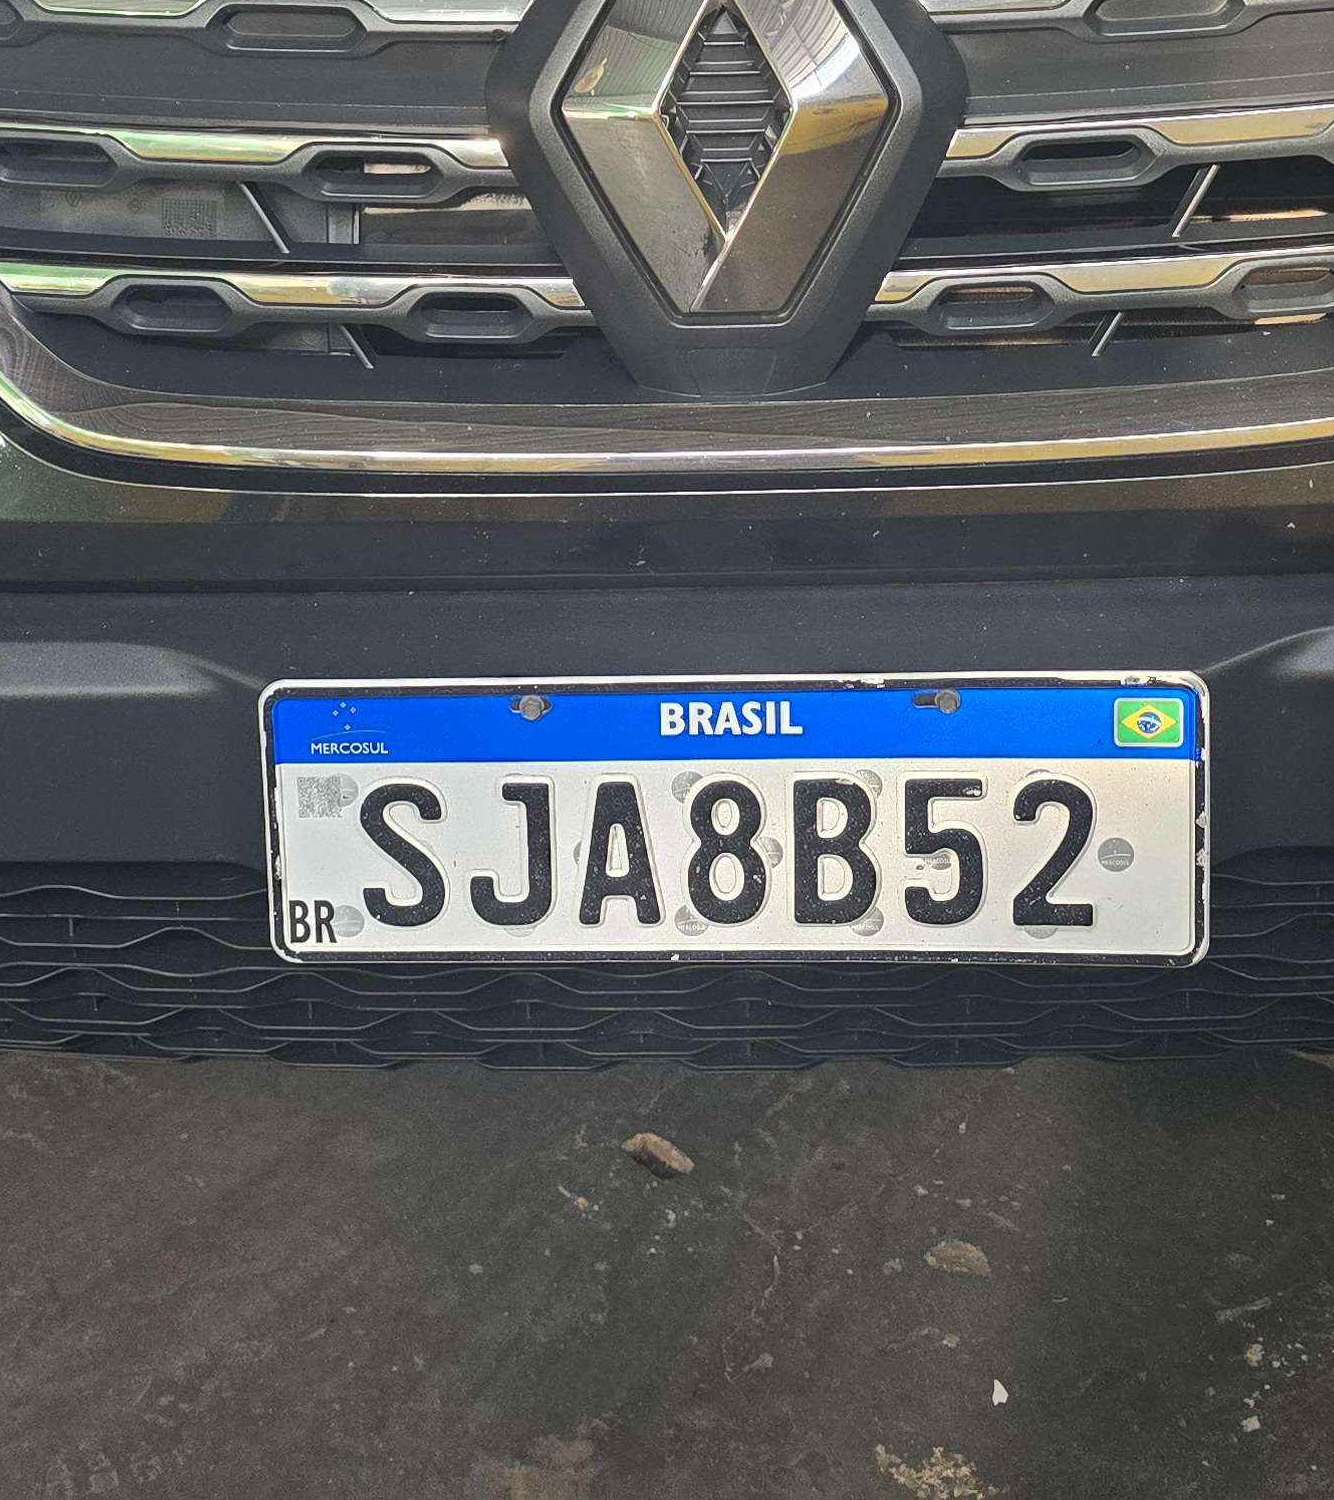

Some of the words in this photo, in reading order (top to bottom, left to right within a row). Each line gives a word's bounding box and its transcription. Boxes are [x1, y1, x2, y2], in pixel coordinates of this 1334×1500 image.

[658, 701, 803, 736] BRASIL
[311, 742, 388, 754] MERCOSUL
[360, 781, 1097, 928] SJA8B52
[288, 900, 338, 944] BR
